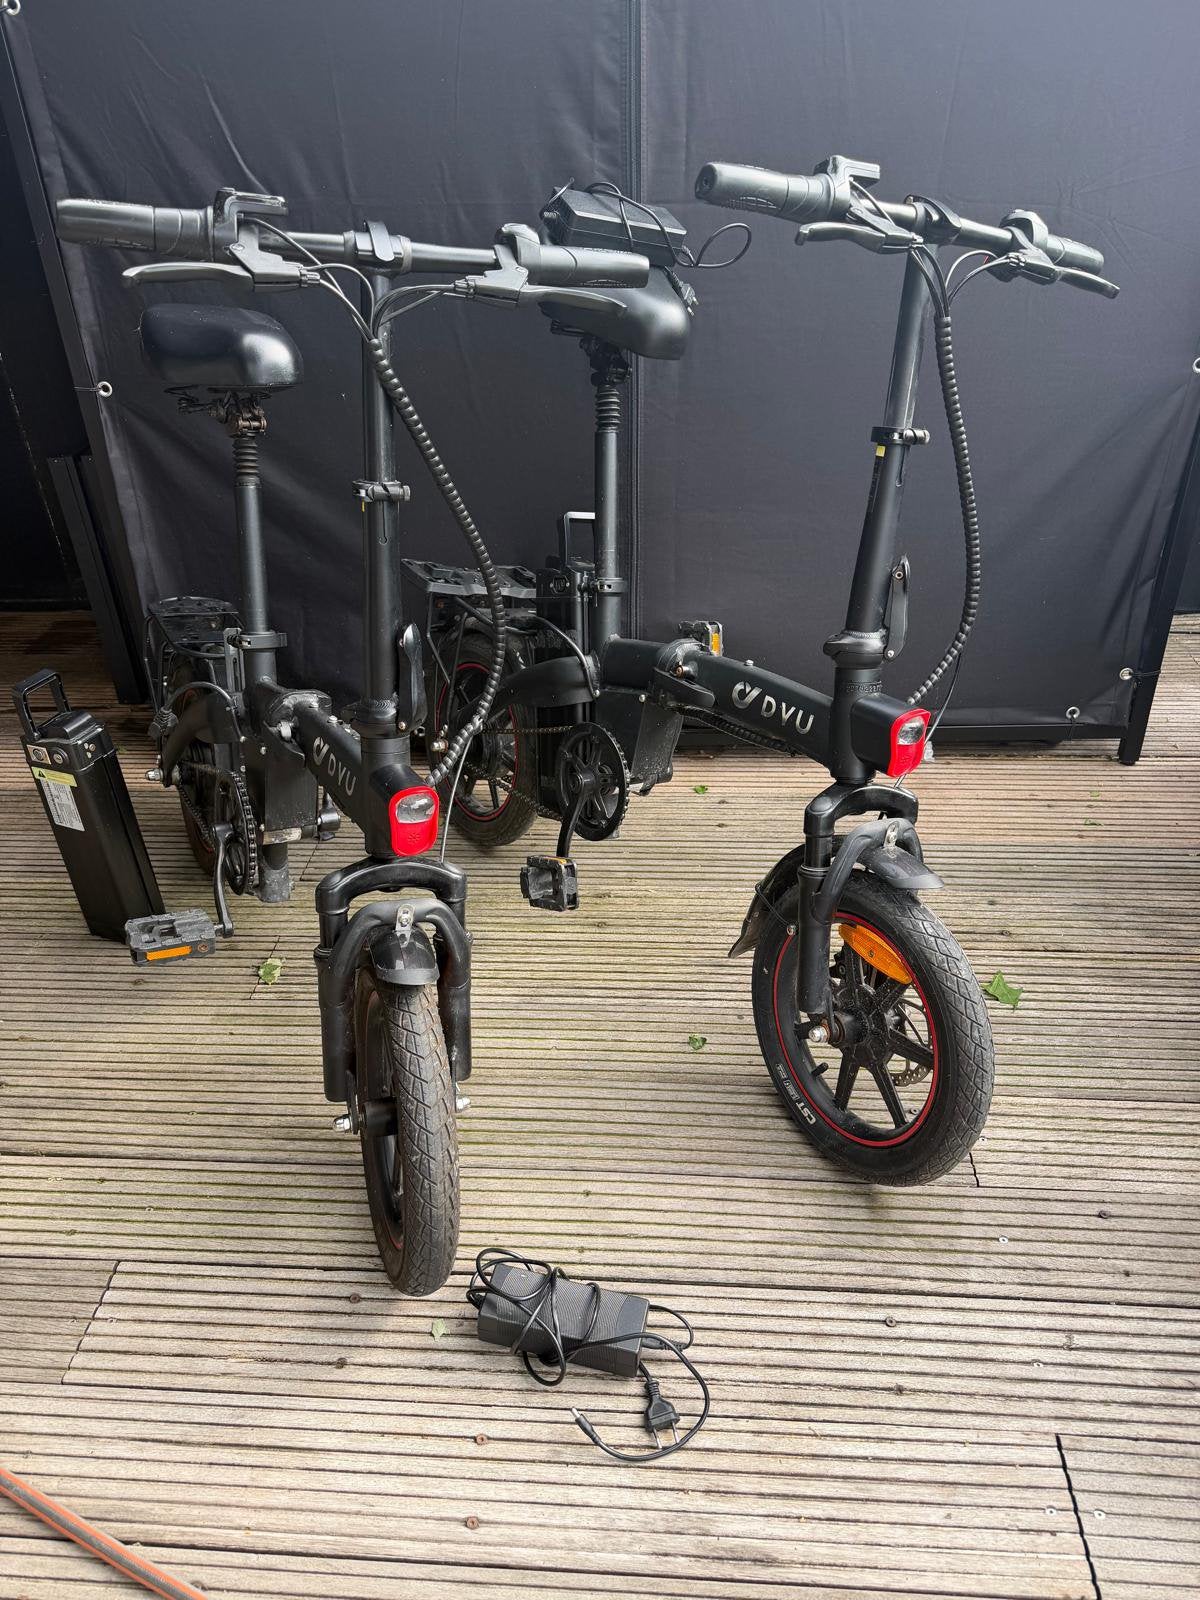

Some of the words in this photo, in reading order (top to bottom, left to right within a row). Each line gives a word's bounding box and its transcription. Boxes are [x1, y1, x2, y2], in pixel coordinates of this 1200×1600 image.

[760, 695, 815, 735] DYU
[327, 753, 357, 796] DYU
[795, 1101, 817, 1125] CST
